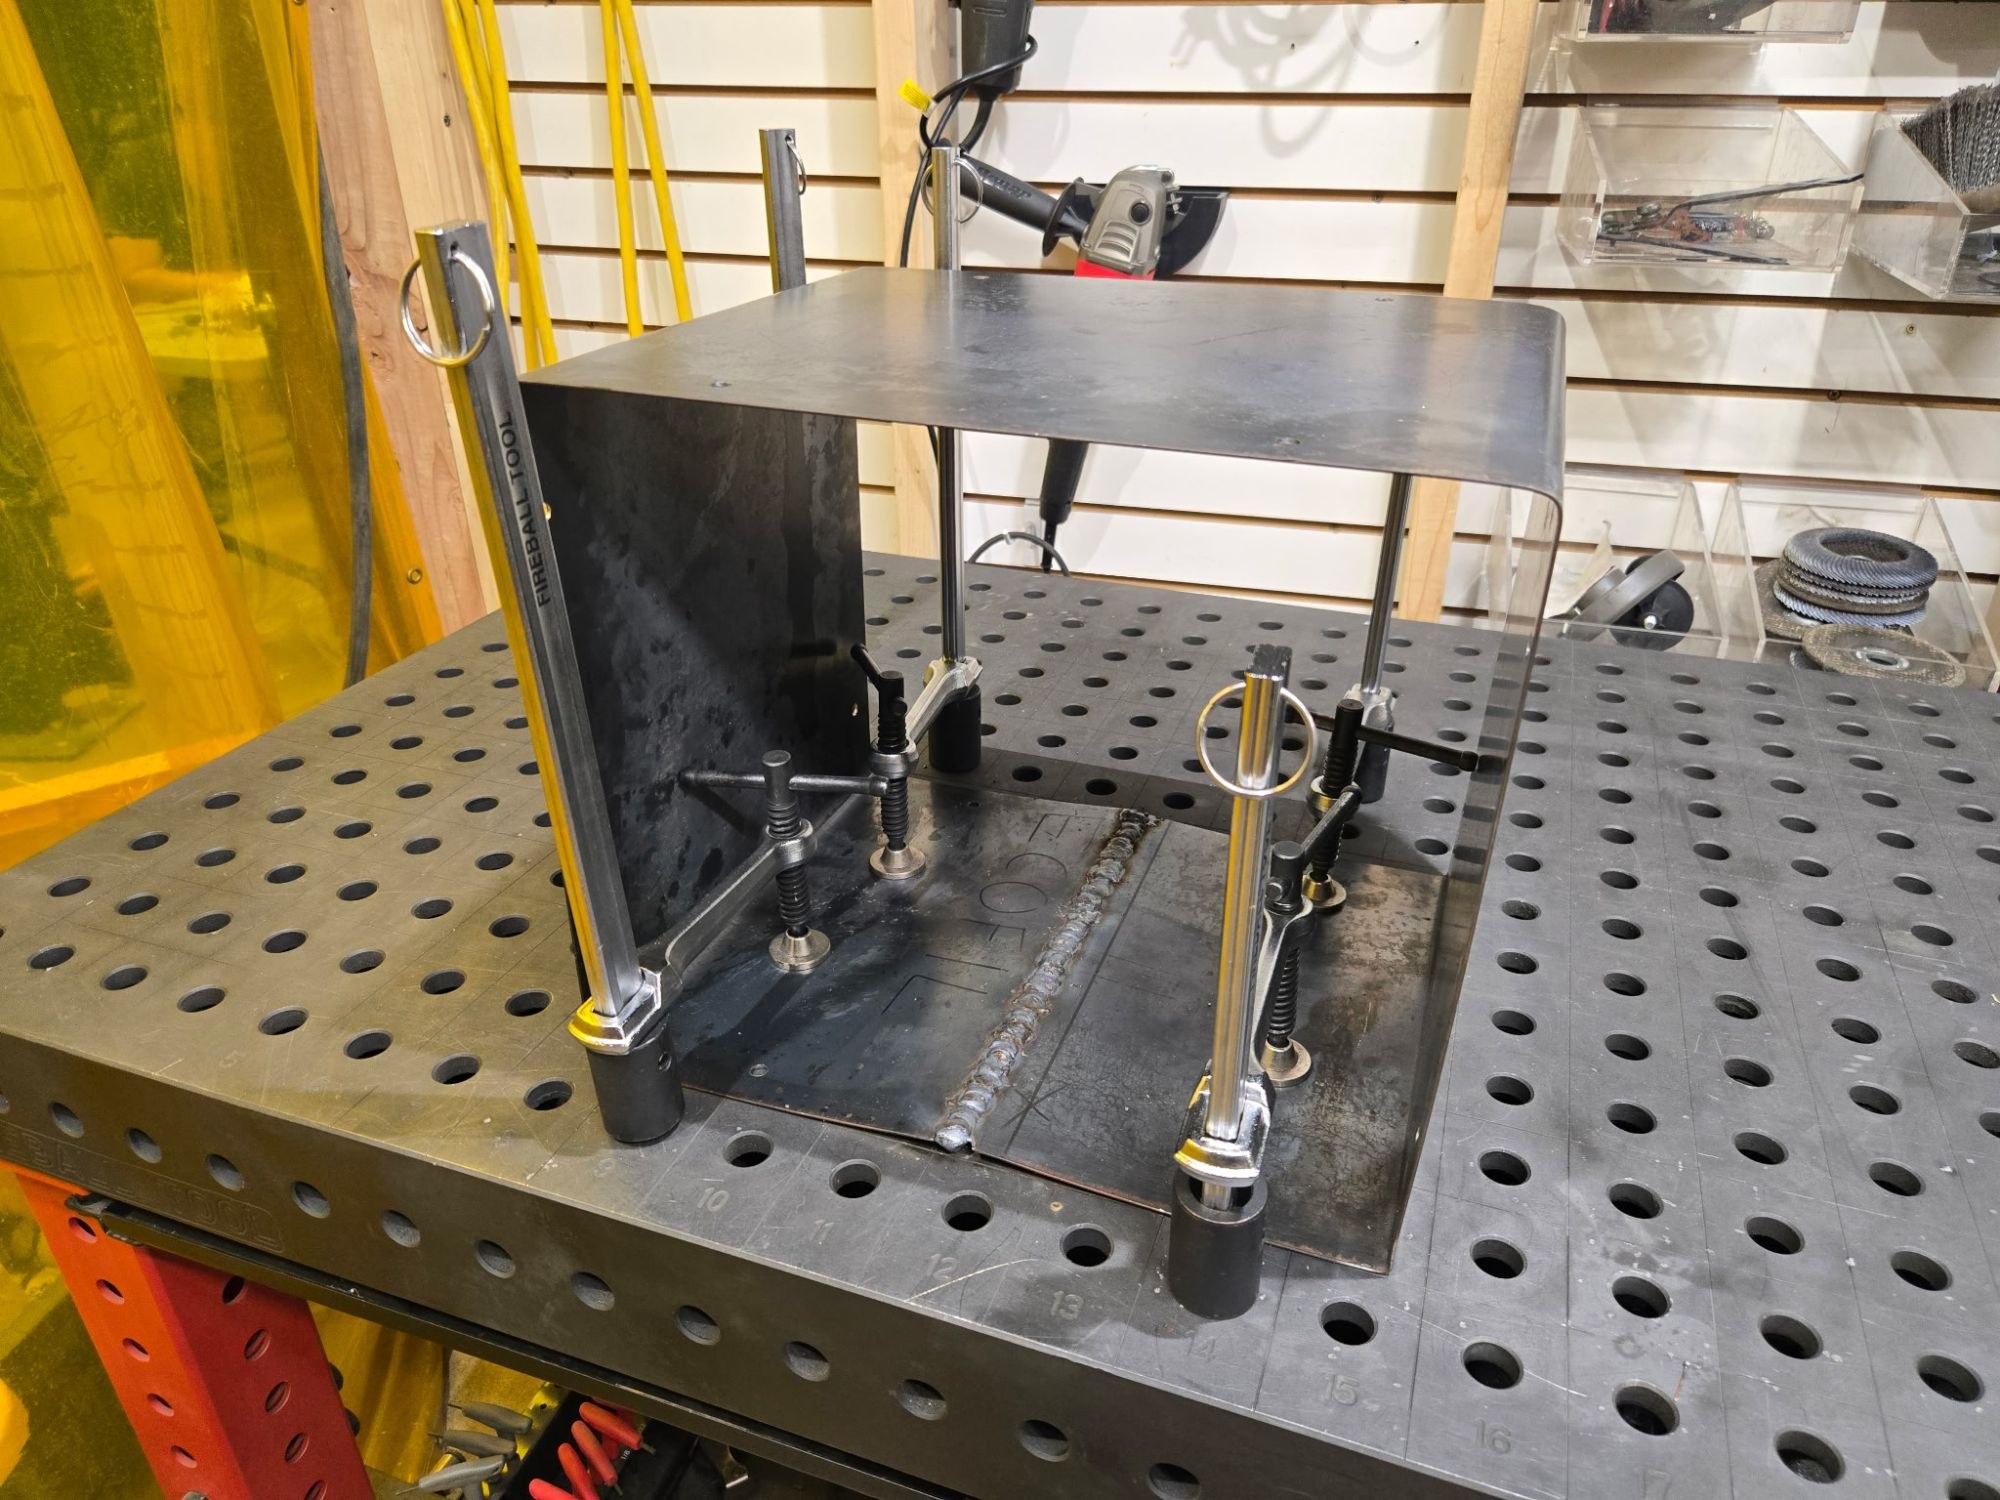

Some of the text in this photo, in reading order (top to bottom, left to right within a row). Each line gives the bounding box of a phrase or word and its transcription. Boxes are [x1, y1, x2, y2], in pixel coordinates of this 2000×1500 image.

[499, 411, 551, 607] FIREBALL TOOL
[697, 1187, 730, 1213] 10
[811, 1219, 834, 1244] 11
[927, 1253, 957, 1281] 12
[1050, 1290, 1085, 1321] 13
[1324, 1373, 1360, 1406] 15
[1474, 1417, 1513, 1455] 16
